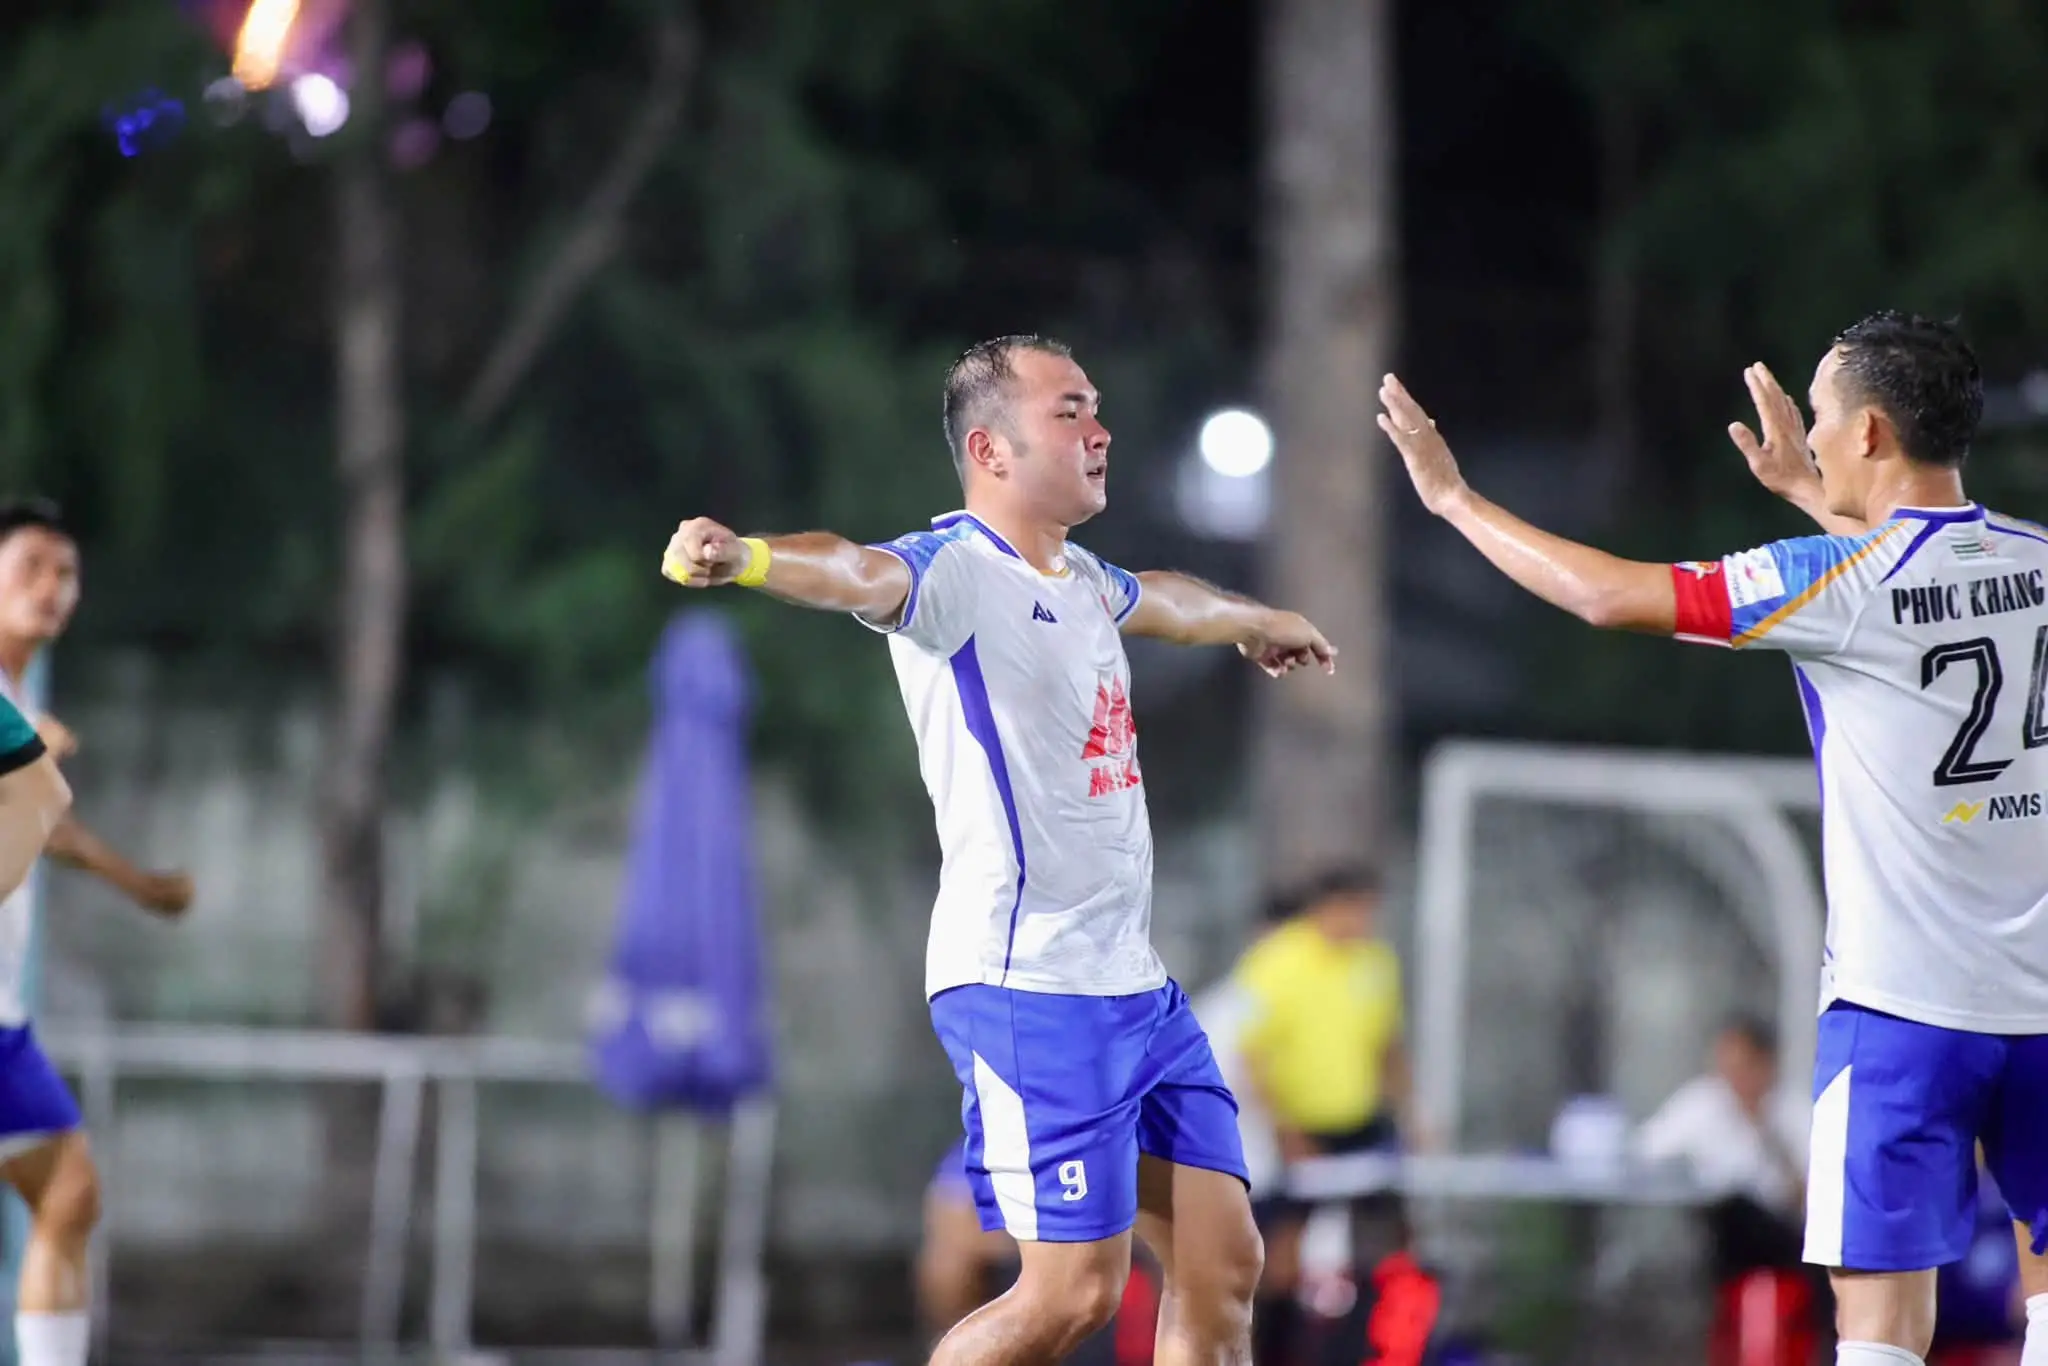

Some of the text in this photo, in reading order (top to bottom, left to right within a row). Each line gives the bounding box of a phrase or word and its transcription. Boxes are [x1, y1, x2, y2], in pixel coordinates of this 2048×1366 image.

[1891, 569, 2045, 625] PHÚC KHANG
[1058, 1160, 1088, 1201] 9
